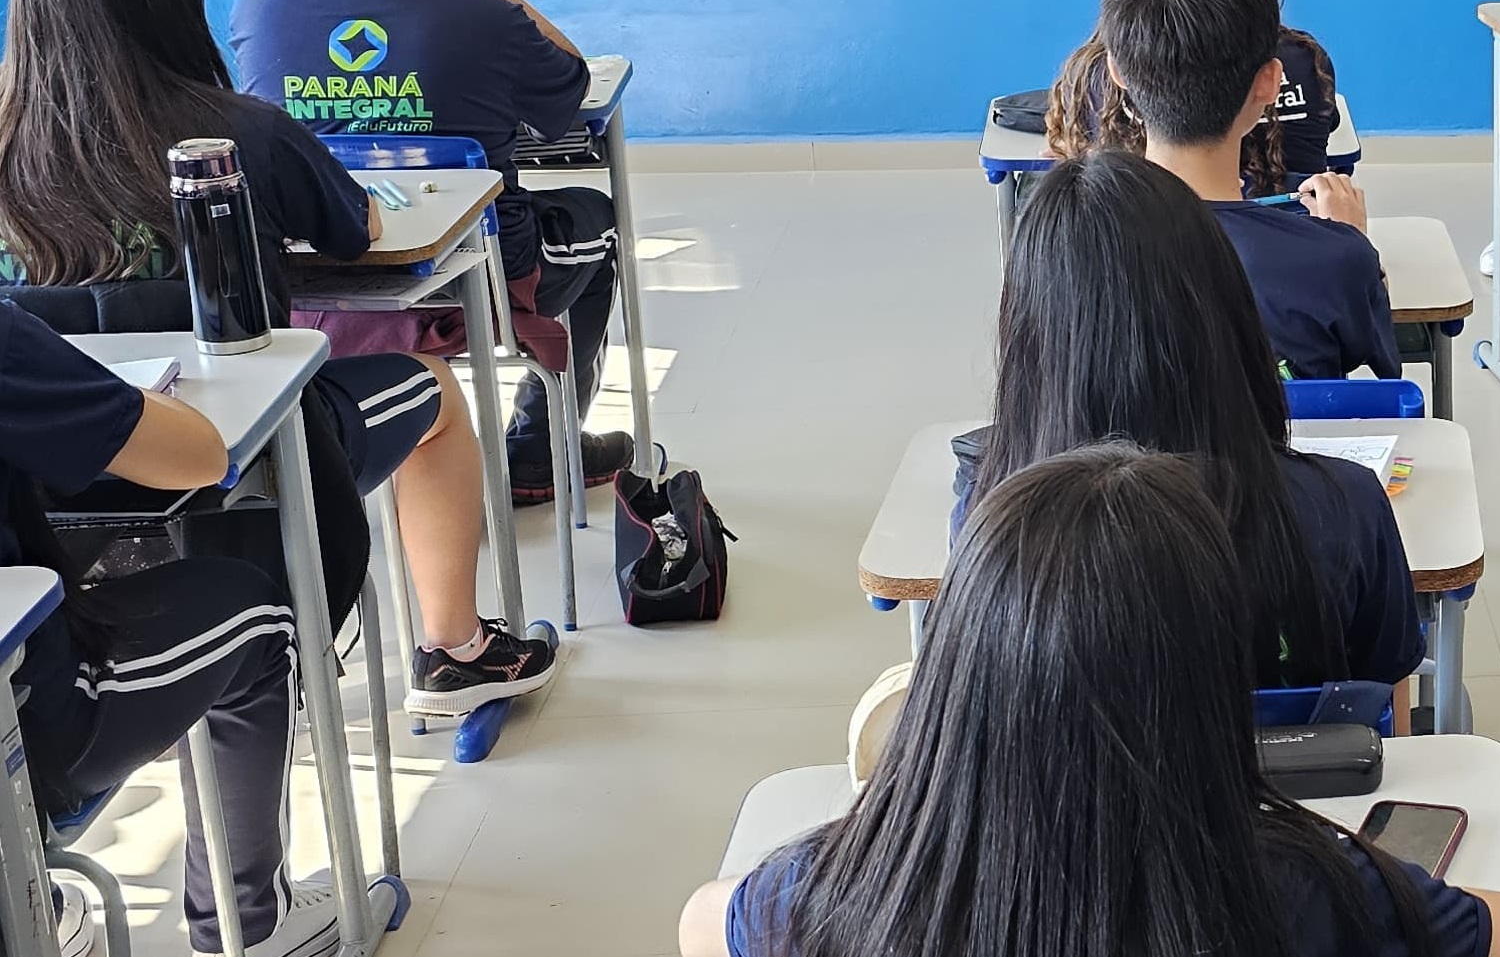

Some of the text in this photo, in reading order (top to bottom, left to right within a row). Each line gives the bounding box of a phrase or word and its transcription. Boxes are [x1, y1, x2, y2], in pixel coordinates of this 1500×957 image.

[284, 71, 424, 99] PARANÁ
[285, 98, 434, 120] INTEGRAL
[348, 120, 433, 133] EduFuturo
